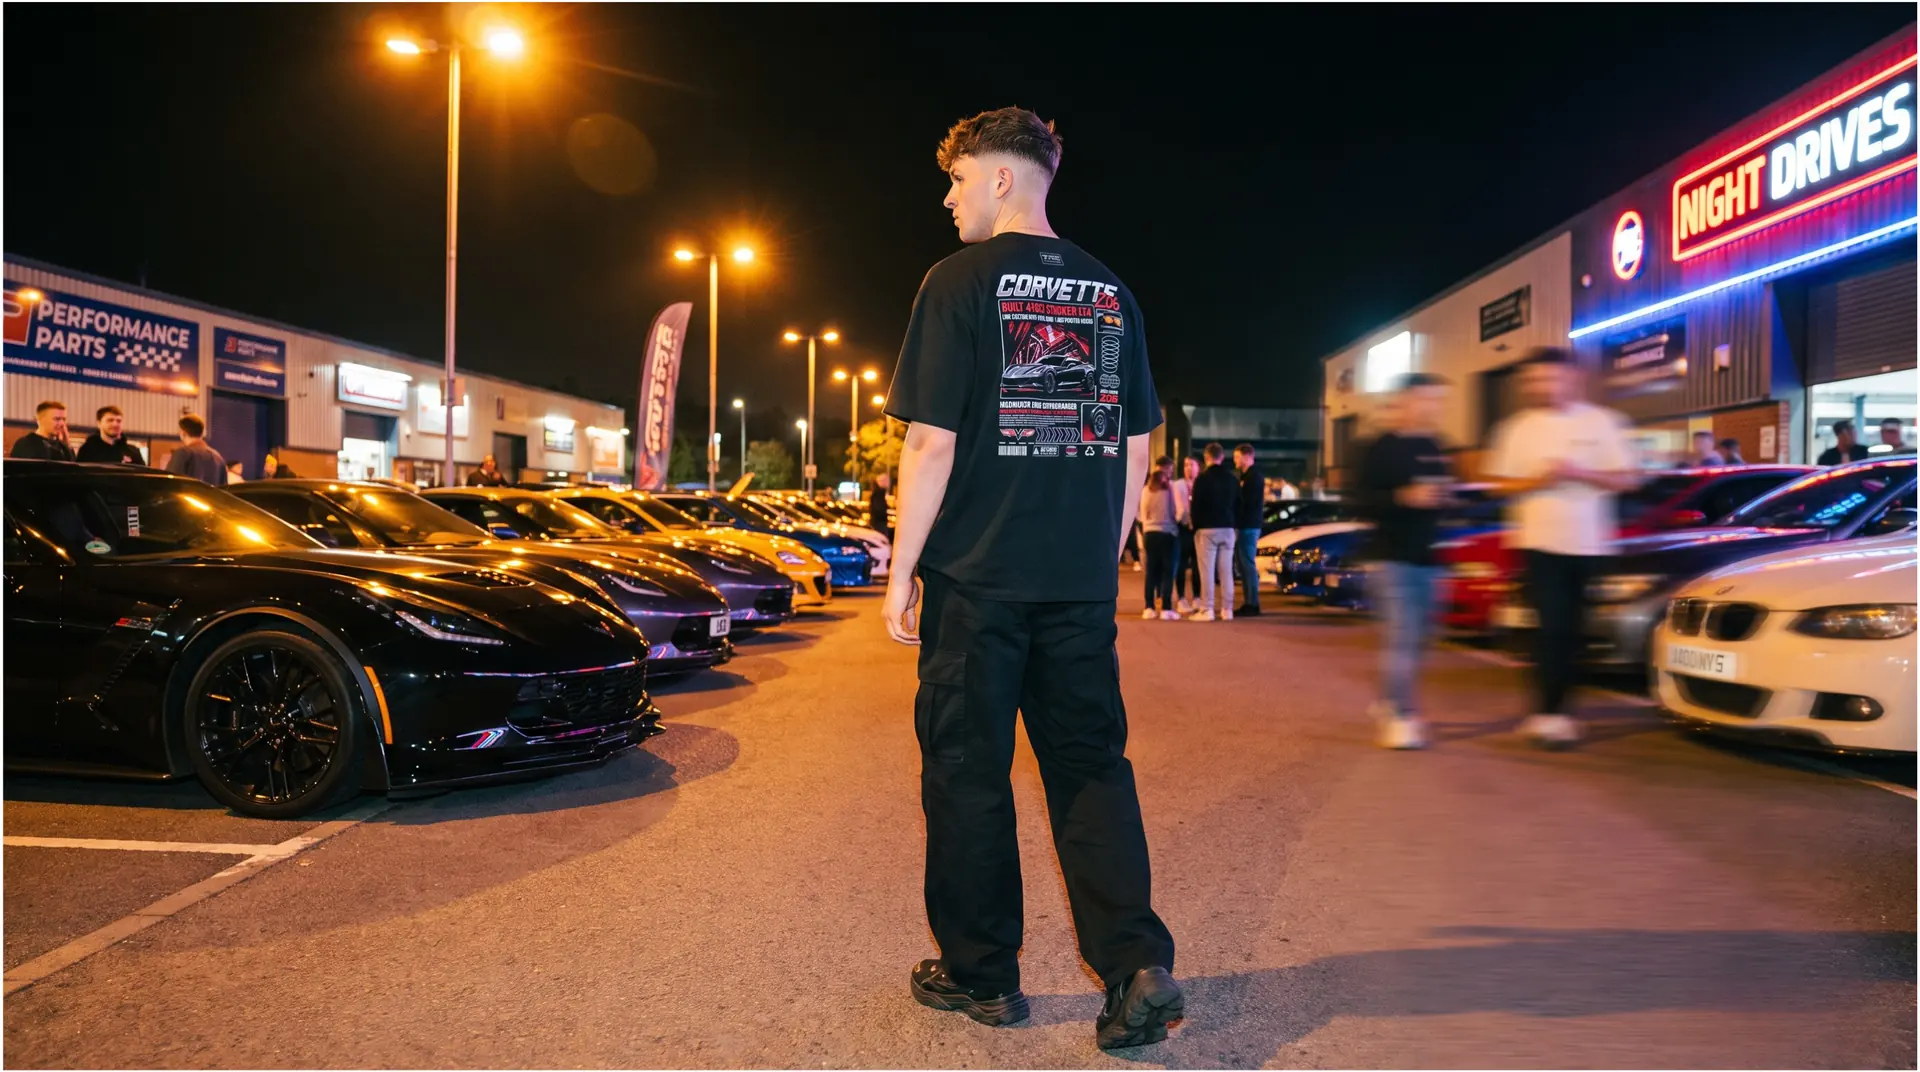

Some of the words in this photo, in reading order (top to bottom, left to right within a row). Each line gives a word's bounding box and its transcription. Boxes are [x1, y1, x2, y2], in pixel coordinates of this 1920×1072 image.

[1679, 154, 1767, 241] NIGHT
[1770, 82, 1911, 201] DRIVES
[996, 274, 1119, 302] CORVETTE
[37, 299, 191, 350] PERFORMANCE
[1001, 302, 1024, 313] BUILT
[35, 326, 107, 360] PARTS
